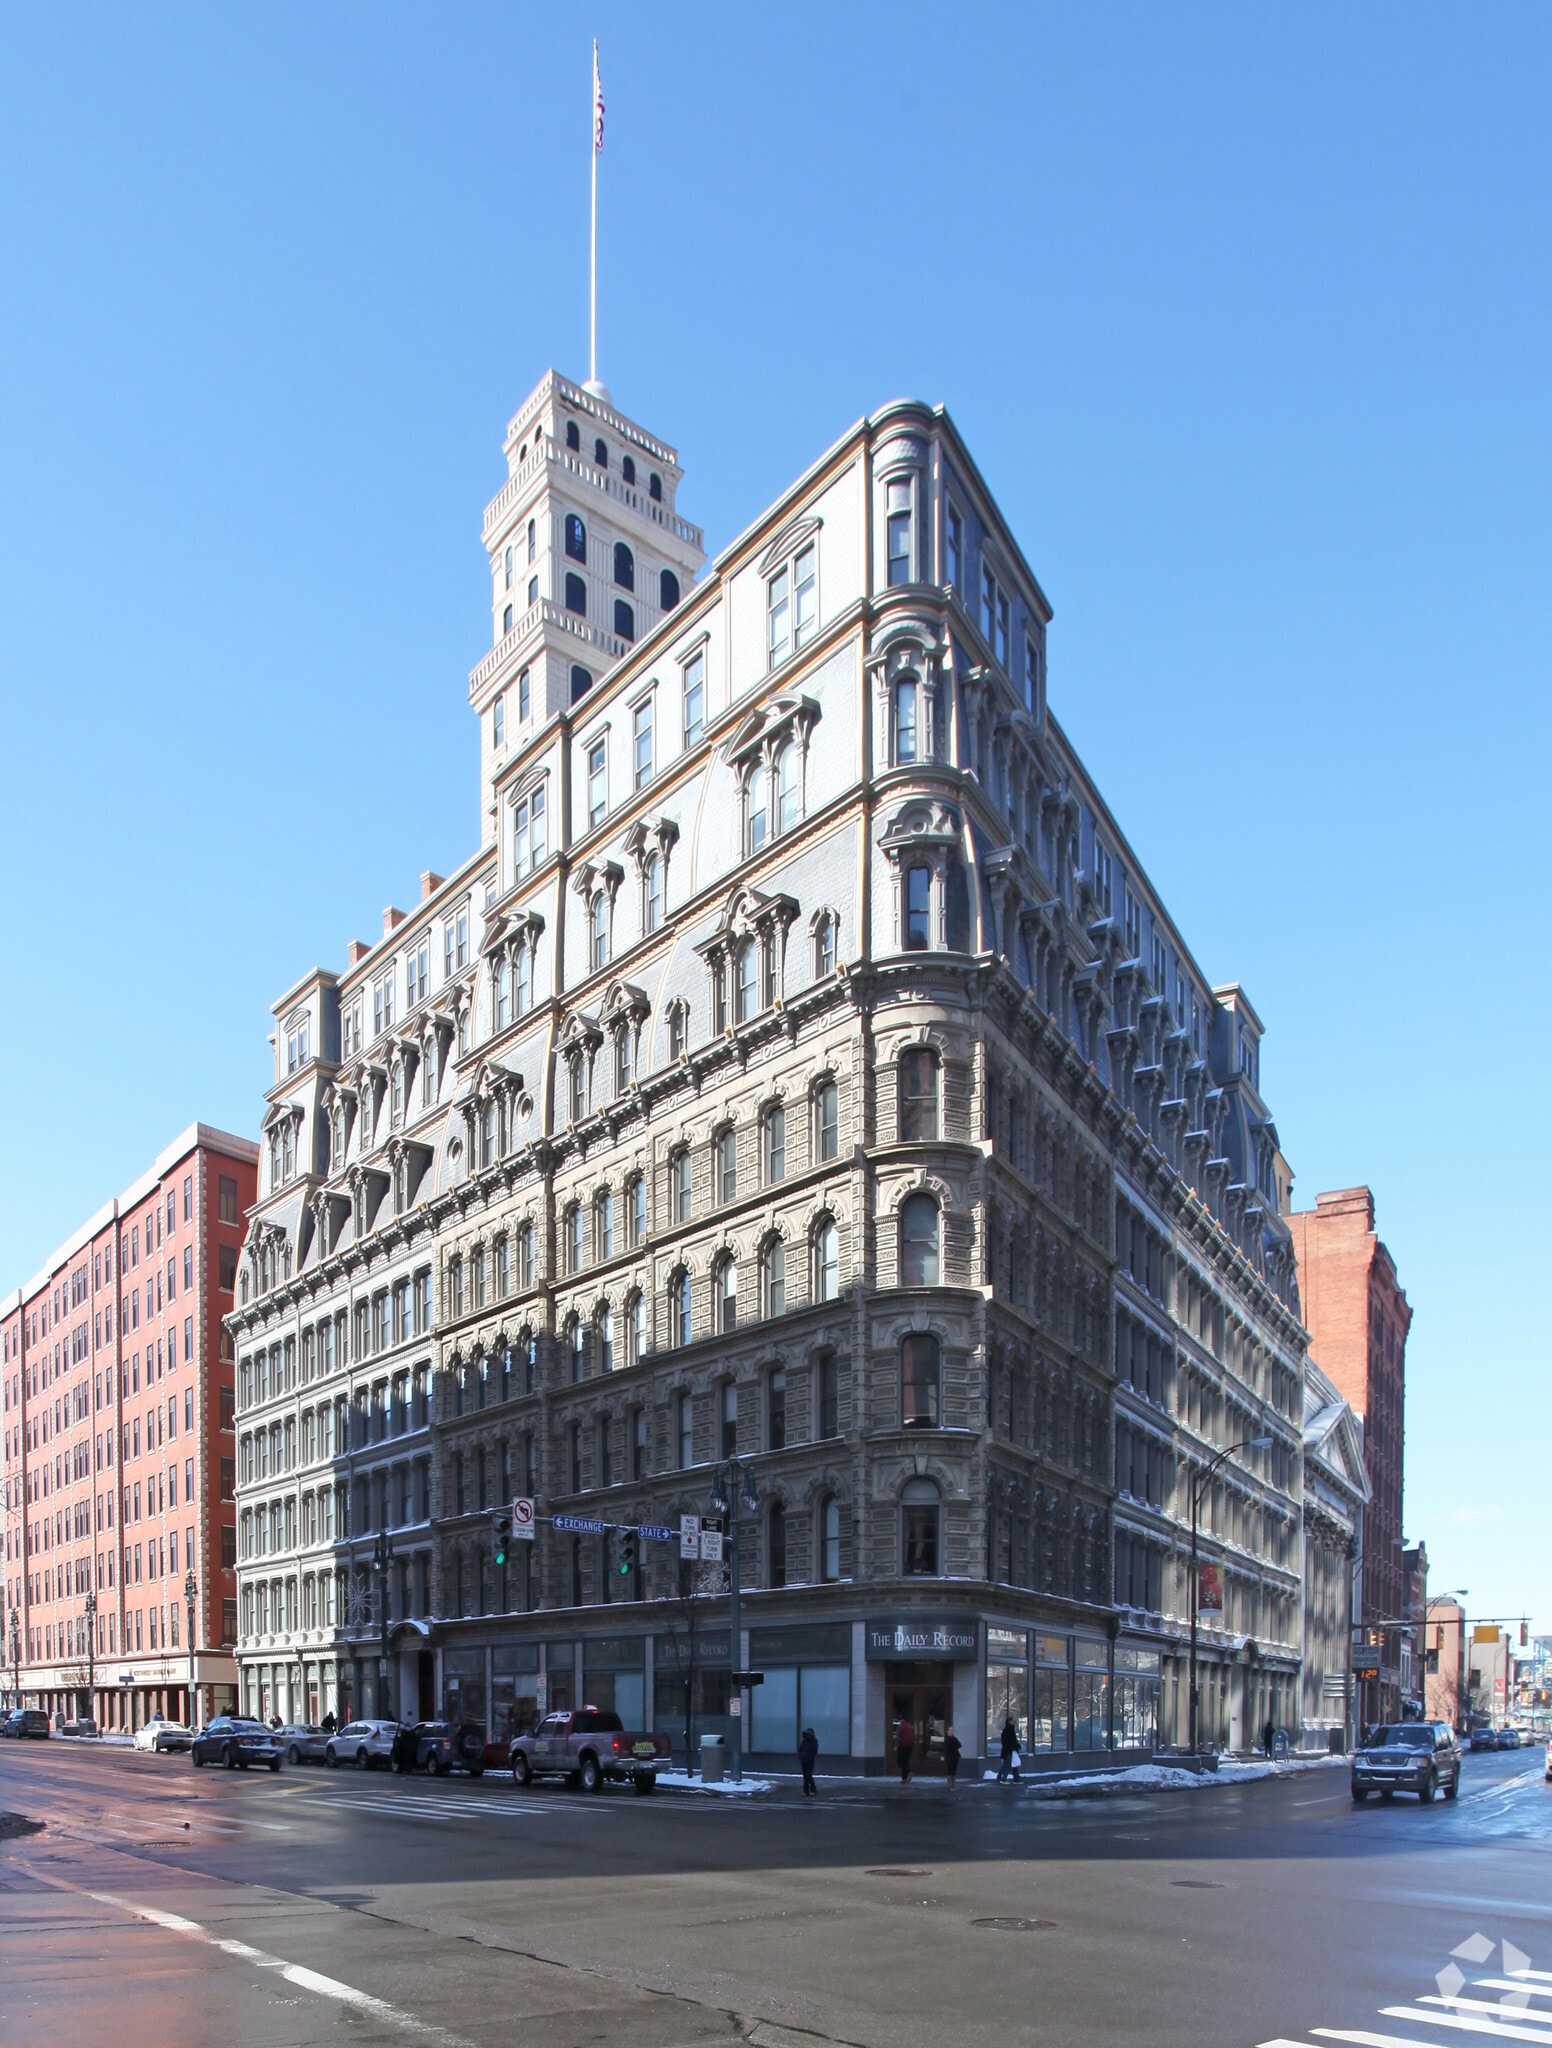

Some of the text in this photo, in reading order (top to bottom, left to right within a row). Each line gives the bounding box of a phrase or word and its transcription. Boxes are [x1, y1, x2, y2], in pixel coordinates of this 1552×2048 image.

[564, 1518, 602, 1533] EXCHANGE
[640, 1527, 662, 1538] STATE
[871, 1631, 975, 1647] THE DAILY RECORD
